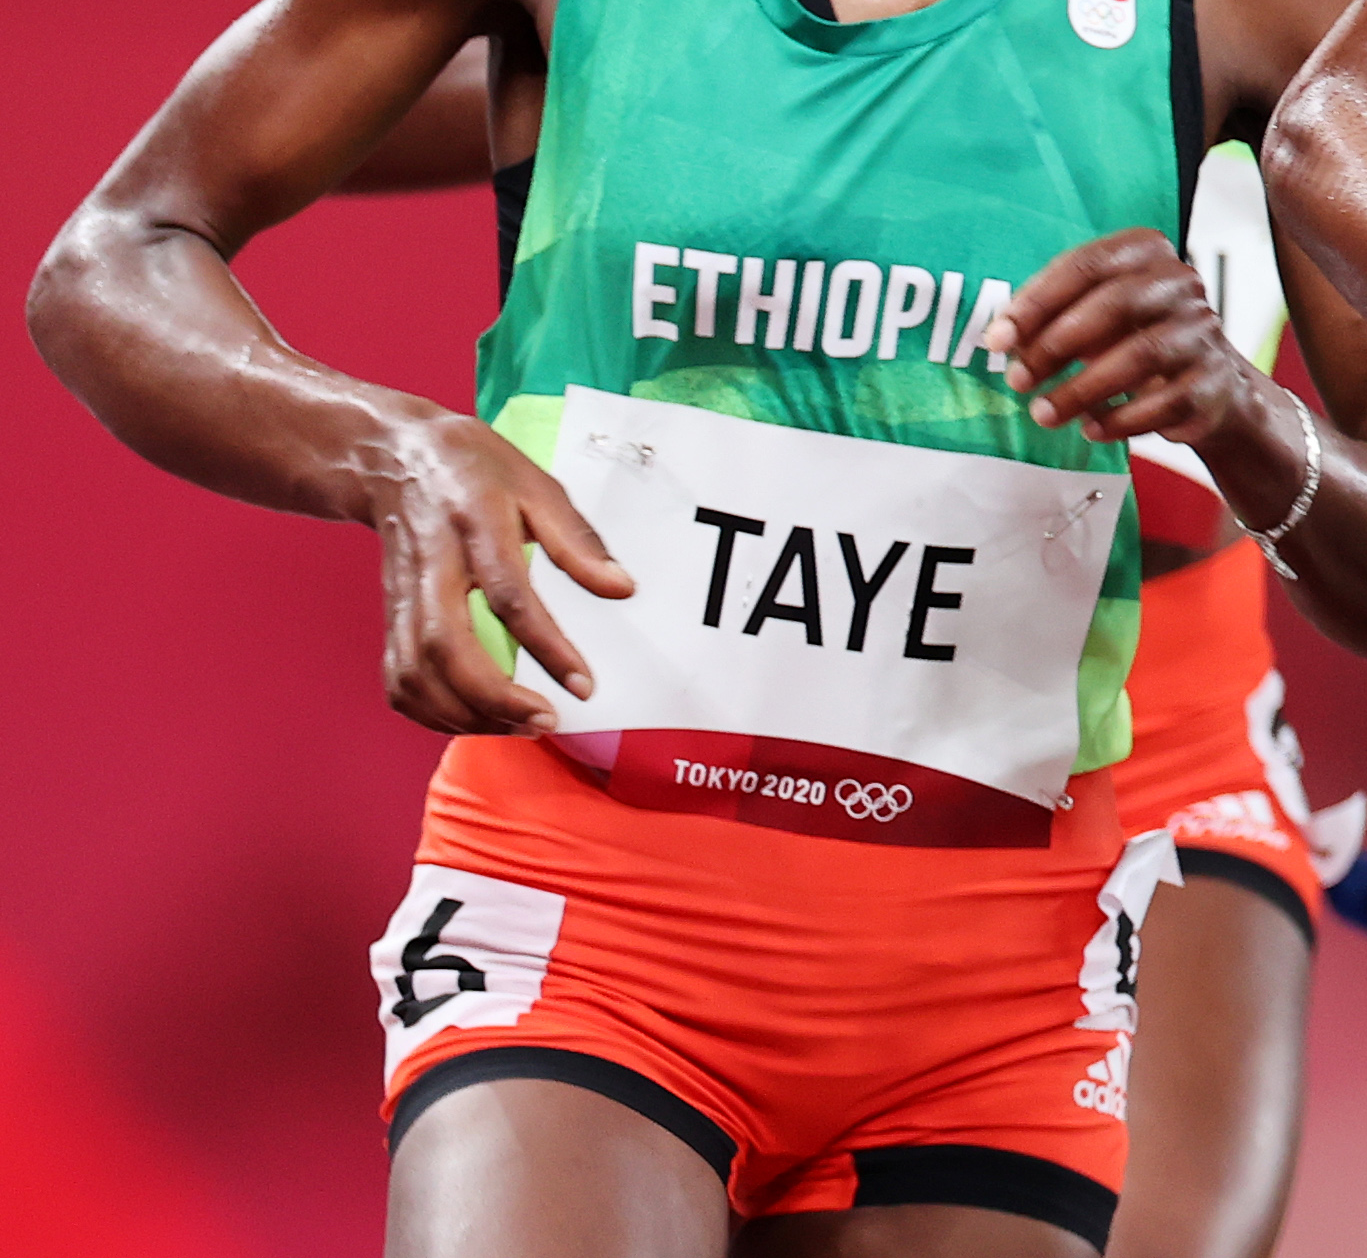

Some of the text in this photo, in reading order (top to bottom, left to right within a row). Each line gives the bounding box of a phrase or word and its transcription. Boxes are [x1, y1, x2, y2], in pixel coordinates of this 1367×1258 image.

[632, 241, 1012, 373] ETHIOPIA
[694, 507, 976, 662] TAYE
[673, 758, 826, 806] TOKYO 2020
